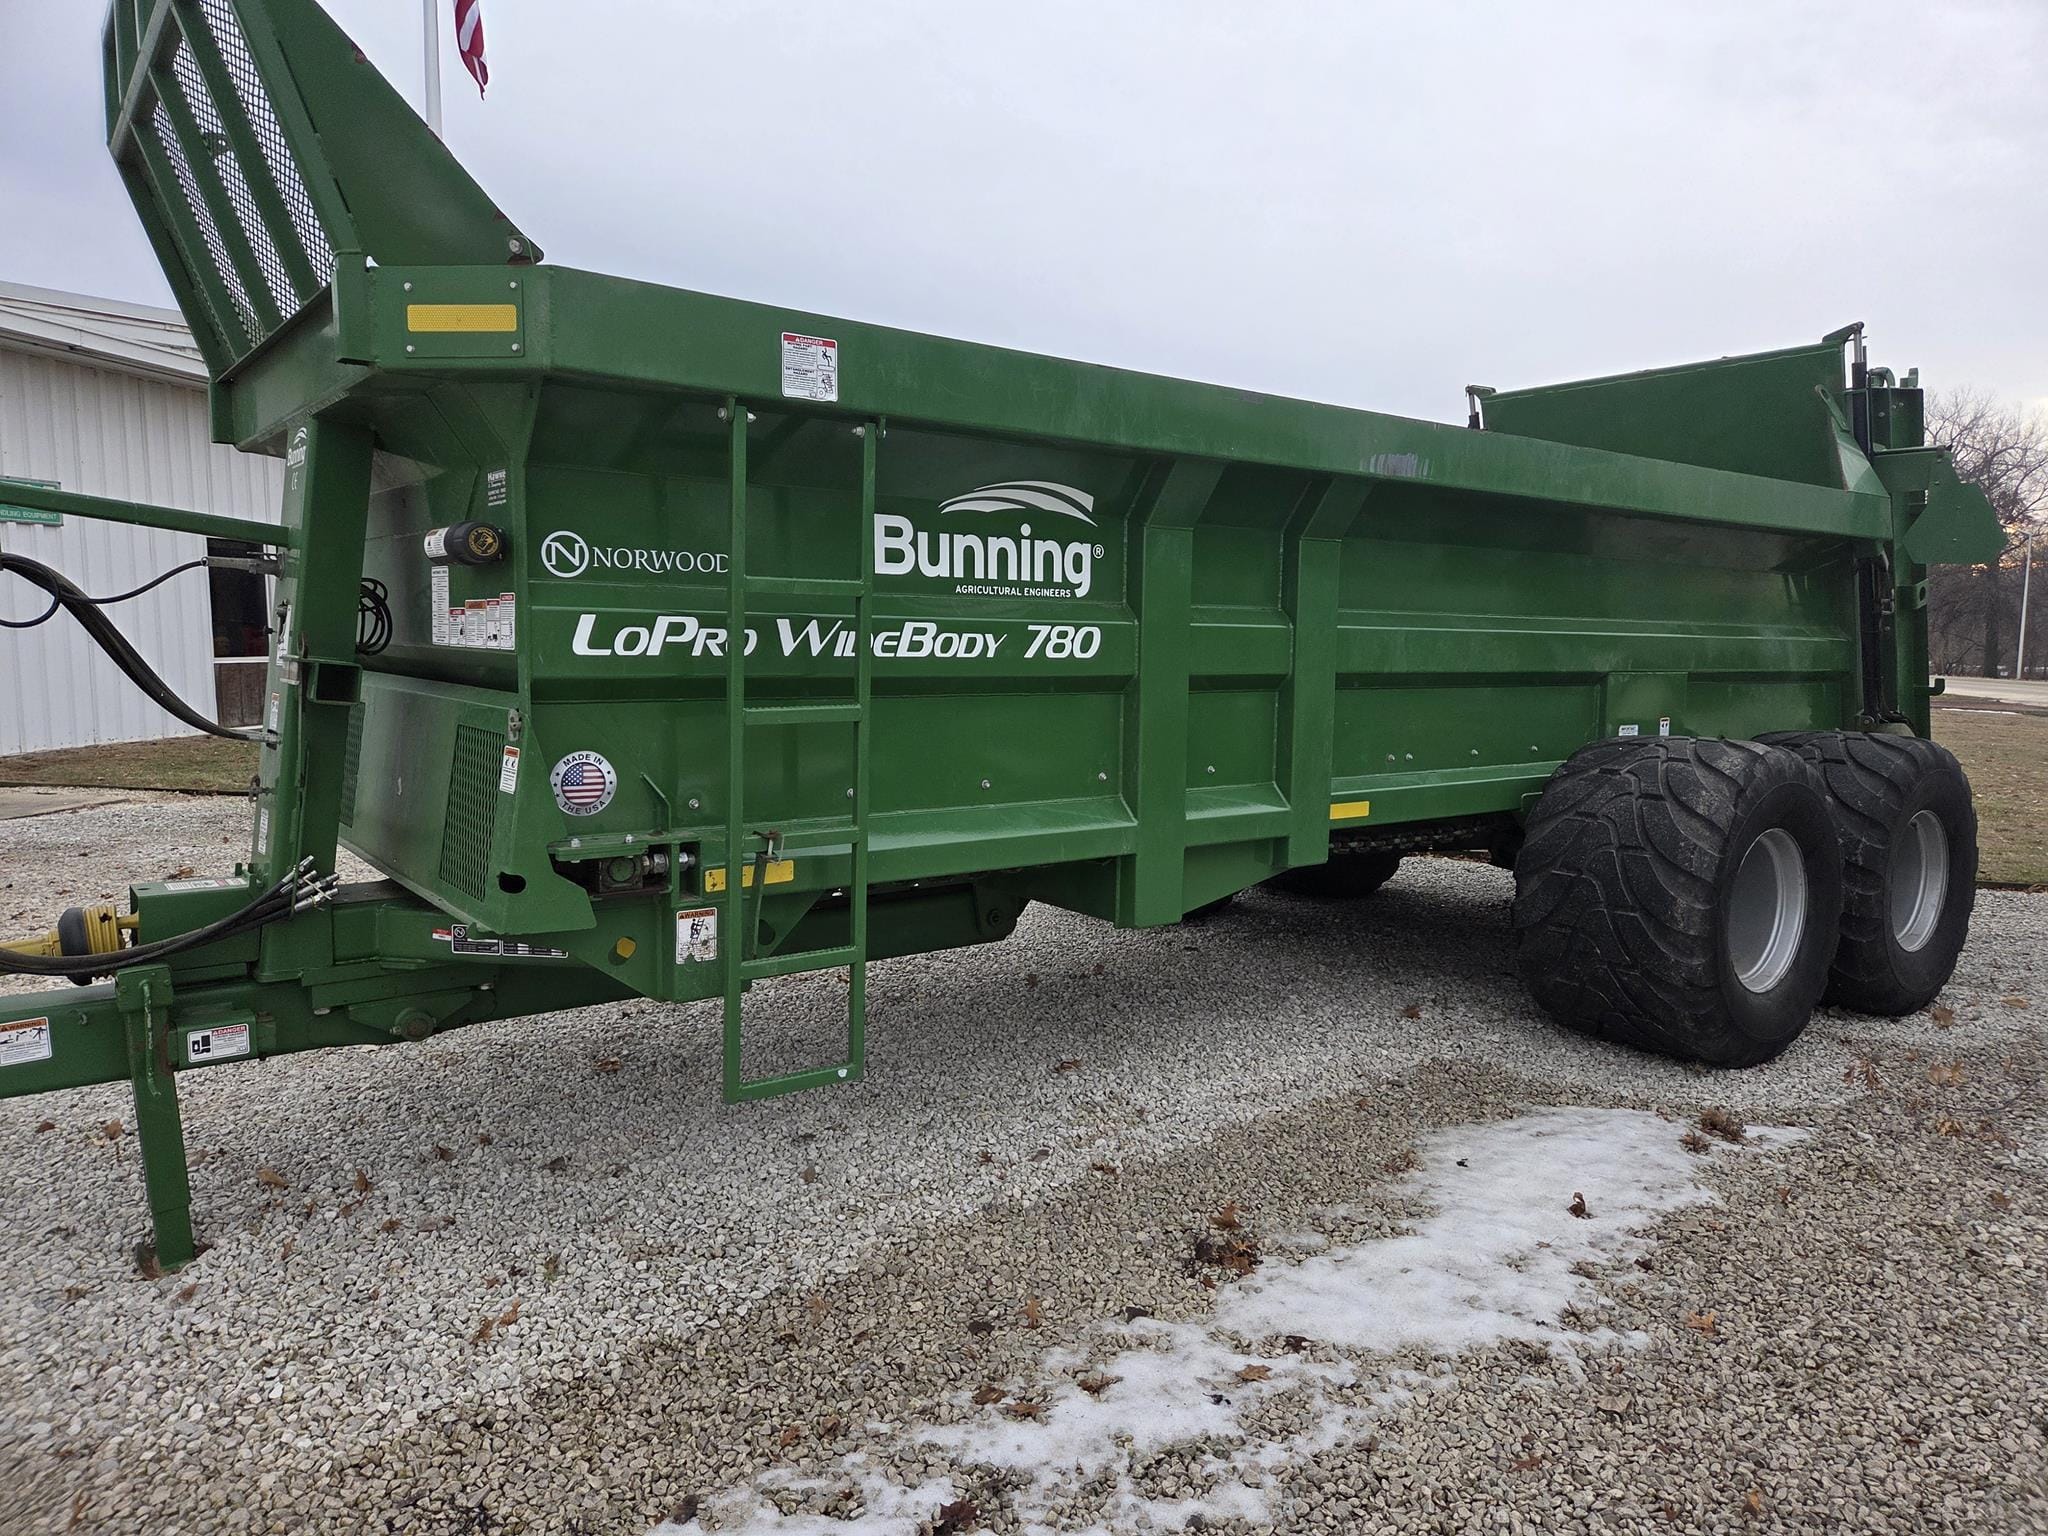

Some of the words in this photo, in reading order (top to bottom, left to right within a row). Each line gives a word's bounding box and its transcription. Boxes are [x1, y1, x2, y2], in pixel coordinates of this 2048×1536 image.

[800, 337, 824, 346] DANGER
[23, 511, 57, 520] EQUIPMENT
[955, 584, 1022, 596] AGRICULTURAL
[1024, 587, 1071, 598] ENGINEERS
[1023, 624, 1101, 659] 780
[562, 753, 591, 768] MADE
[593, 755, 604, 766] IN
[561, 801, 581, 815] THE
[585, 800, 606, 815] USA
[685, 910, 714, 918] WARNING
[9, 1020, 42, 1030] WARNING
[217, 1026, 246, 1035] DANGER
